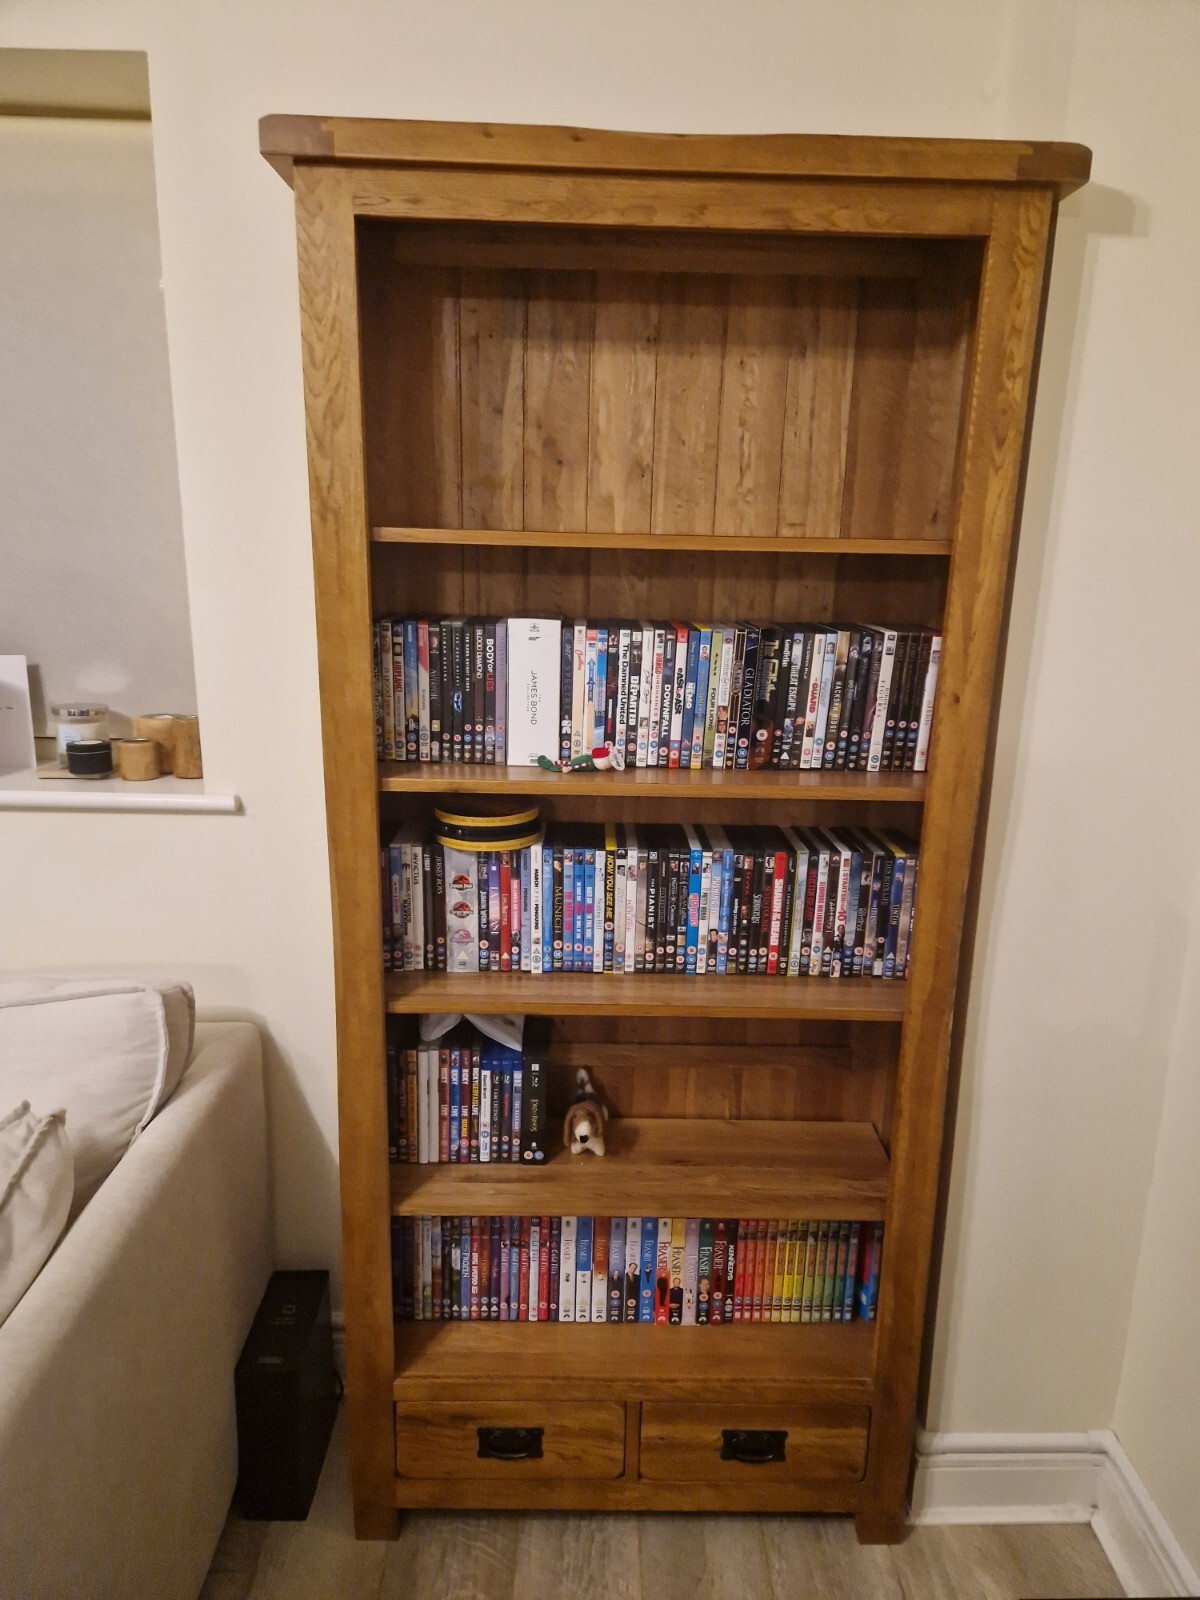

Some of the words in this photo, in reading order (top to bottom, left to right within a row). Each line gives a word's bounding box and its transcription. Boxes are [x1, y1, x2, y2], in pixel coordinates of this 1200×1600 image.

[486, 638, 495, 664] BODY
[622, 643, 630, 659] The
[764, 640, 779, 656] The
[654, 652, 663, 675] DJANGO
[790, 666, 800, 687] GREAT
[486, 672, 494, 692] LIES
[530, 671, 538, 699] JAMES
[620, 661, 629, 695] Damned
[759, 659, 778, 702] Godfather
[629, 675, 640, 726] DEPARTED
[741, 668, 754, 727] GLADIATOR
[788, 687, 798, 712] ESCAPE
[809, 682, 819, 713] GUARD
[530, 701, 539, 726] BOND
[618, 697, 627, 725] United
[661, 684, 671, 739] DOWNFALL
[648, 888, 656, 929] PIANIST
[773, 879, 784, 912] SHAUN
[554, 886, 563, 933] MUNICH
[606, 907, 612, 918] ME
[838, 911, 846, 921] 10
[770, 921, 781, 946] DEAD
[451, 1105, 459, 1117] LIVE
[564, 1240, 572, 1260] FRASIER
[579, 1239, 588, 1261] FRASIER
[596, 1240, 605, 1261] FRASIER
[612, 1240, 622, 1263] FRASIER
[644, 1240, 654, 1262] FRASIER
[658, 1242, 671, 1271] FRASIER
[672, 1247, 685, 1275] FRASIER
[700, 1247, 712, 1275] FRASIER
[714, 1240, 727, 1269] FRASIER
[727, 1245, 735, 1280] KENNEDYS
[462, 1252, 470, 1278] FROZEN
